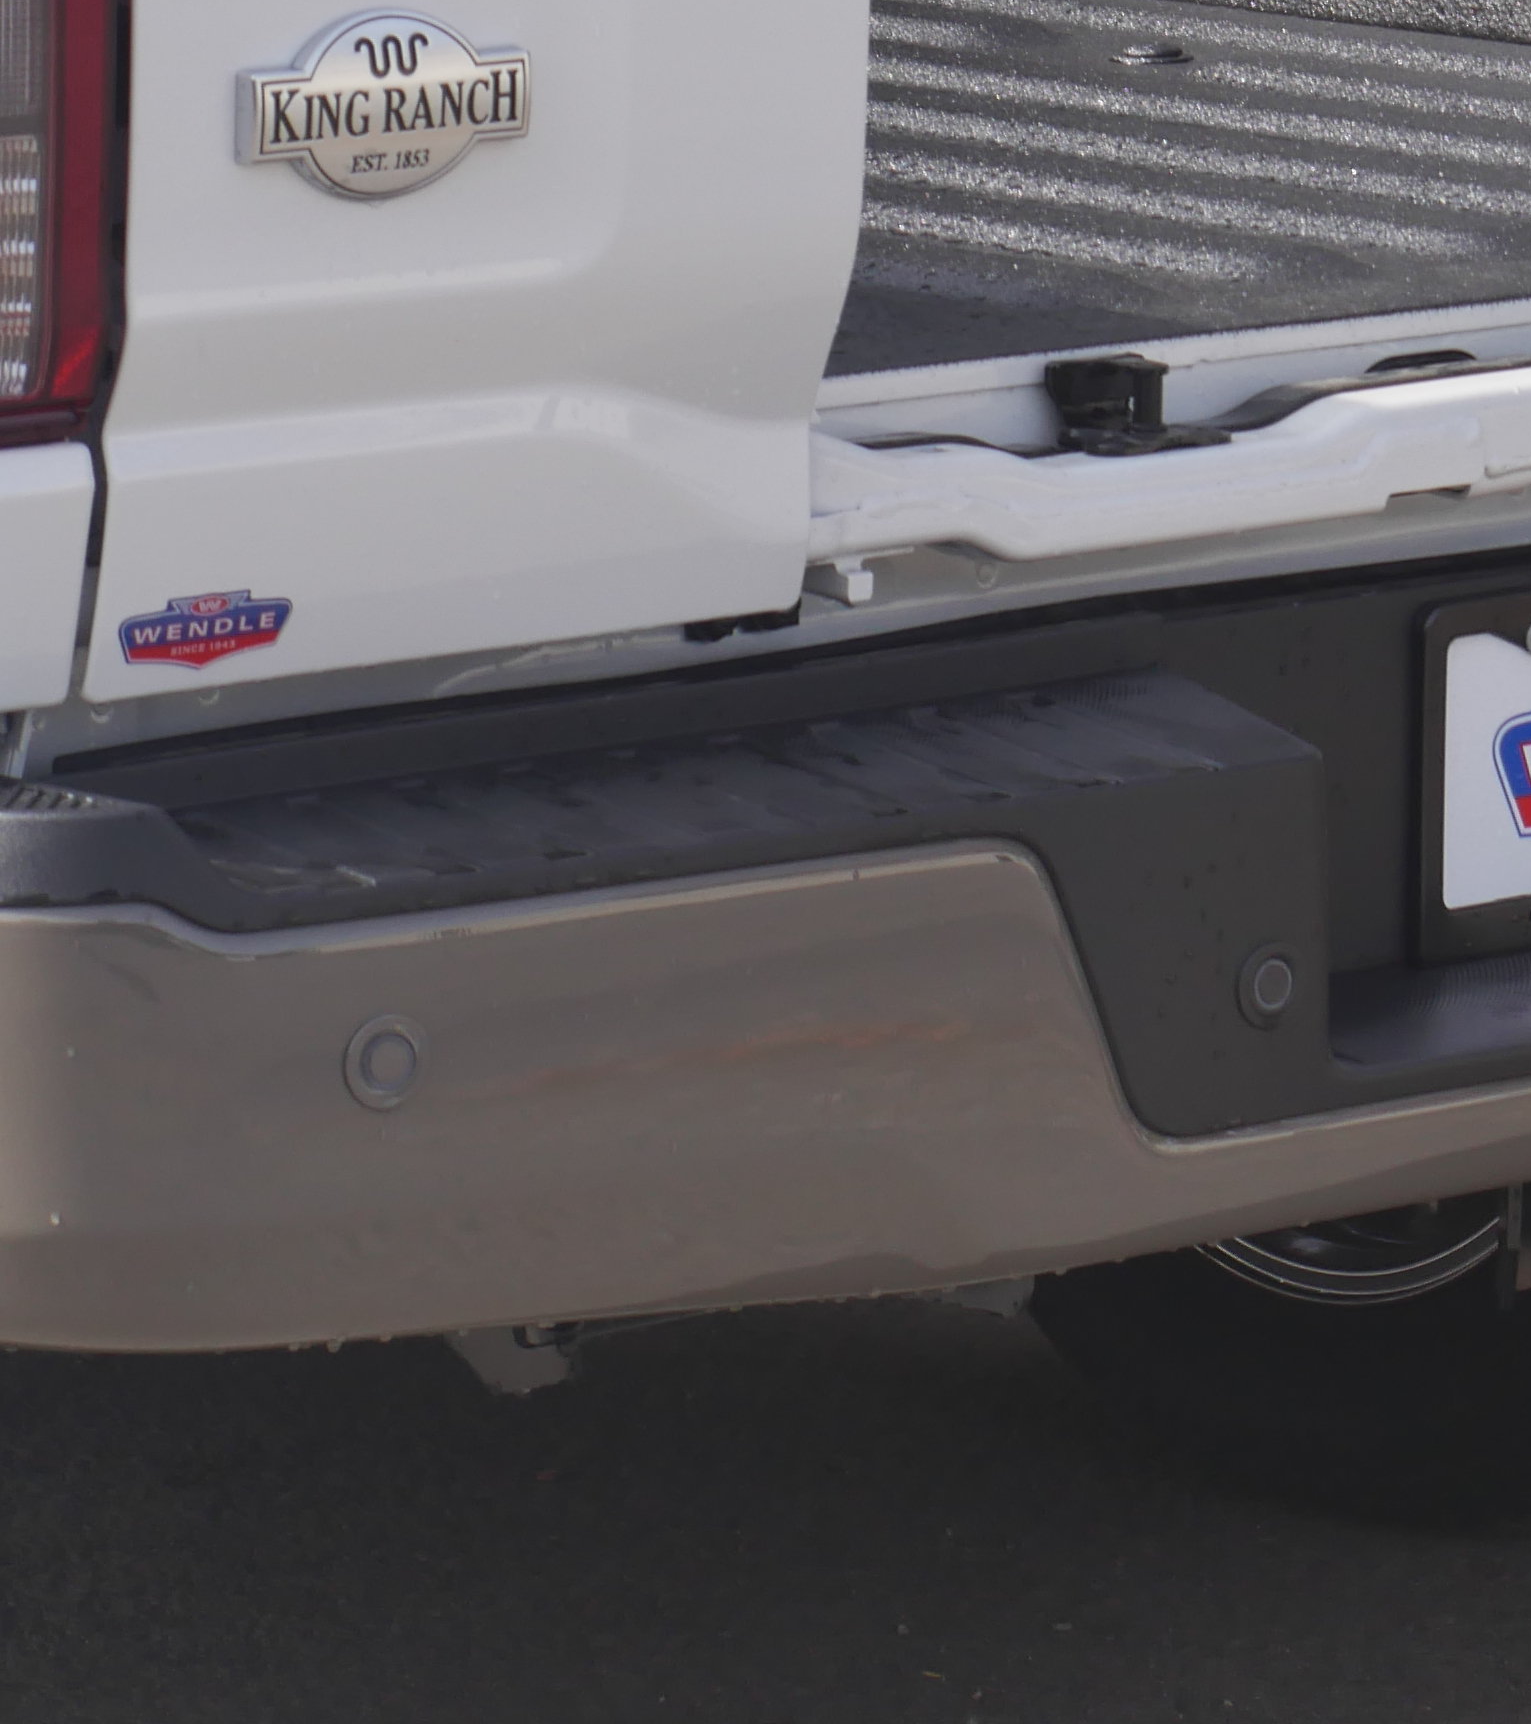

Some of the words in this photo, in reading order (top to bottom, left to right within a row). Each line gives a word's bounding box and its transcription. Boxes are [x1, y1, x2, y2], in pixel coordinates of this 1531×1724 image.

[270, 87, 370, 144] KING
[382, 69, 518, 133] RANCH
[350, 152, 388, 174] EST.
[393, 149, 430, 171] 1853
[133, 611, 276, 645] WENDLE
[170, 642, 205, 656] SINCE
